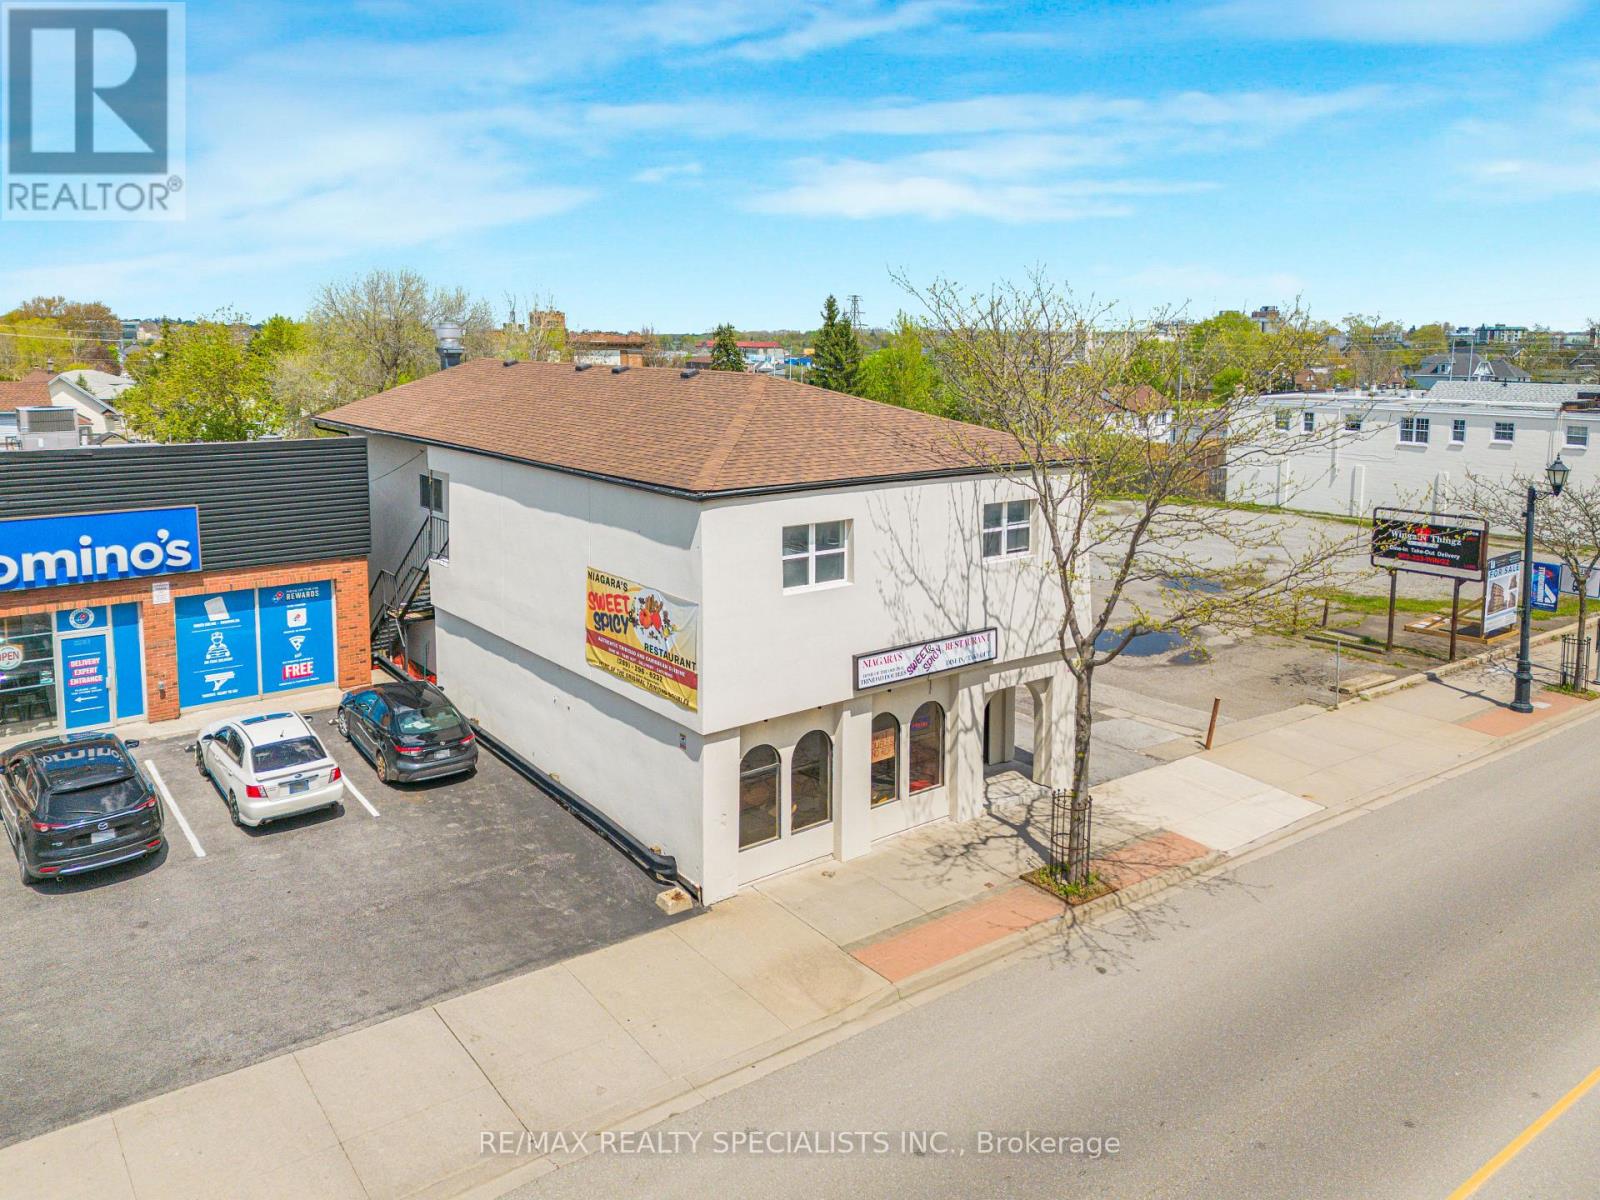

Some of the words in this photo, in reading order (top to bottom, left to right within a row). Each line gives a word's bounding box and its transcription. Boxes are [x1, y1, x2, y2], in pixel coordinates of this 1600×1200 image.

[1431, 534, 1463, 546] Thingz
[1411, 547, 1435, 556] Take-Out
[1437, 551, 1460, 560] Delivery
[1489, 569, 1504, 578] FOR
[1504, 563, 1520, 574] SALE
[587, 571, 629, 592] NIAGARA'S
[285, 590, 319, 601] REWARDS
[588, 591, 630, 614] SWEET
[593, 611, 629, 635] SPICY
[0, 651, 20, 661] PEN
[644, 642, 697, 671] RESTAURANT
[906, 643, 929, 676] SWEET
[923, 644, 942, 672] SPICY
[284, 660, 314, 679] FREE
[70, 675, 104, 686] ENTRANCE
